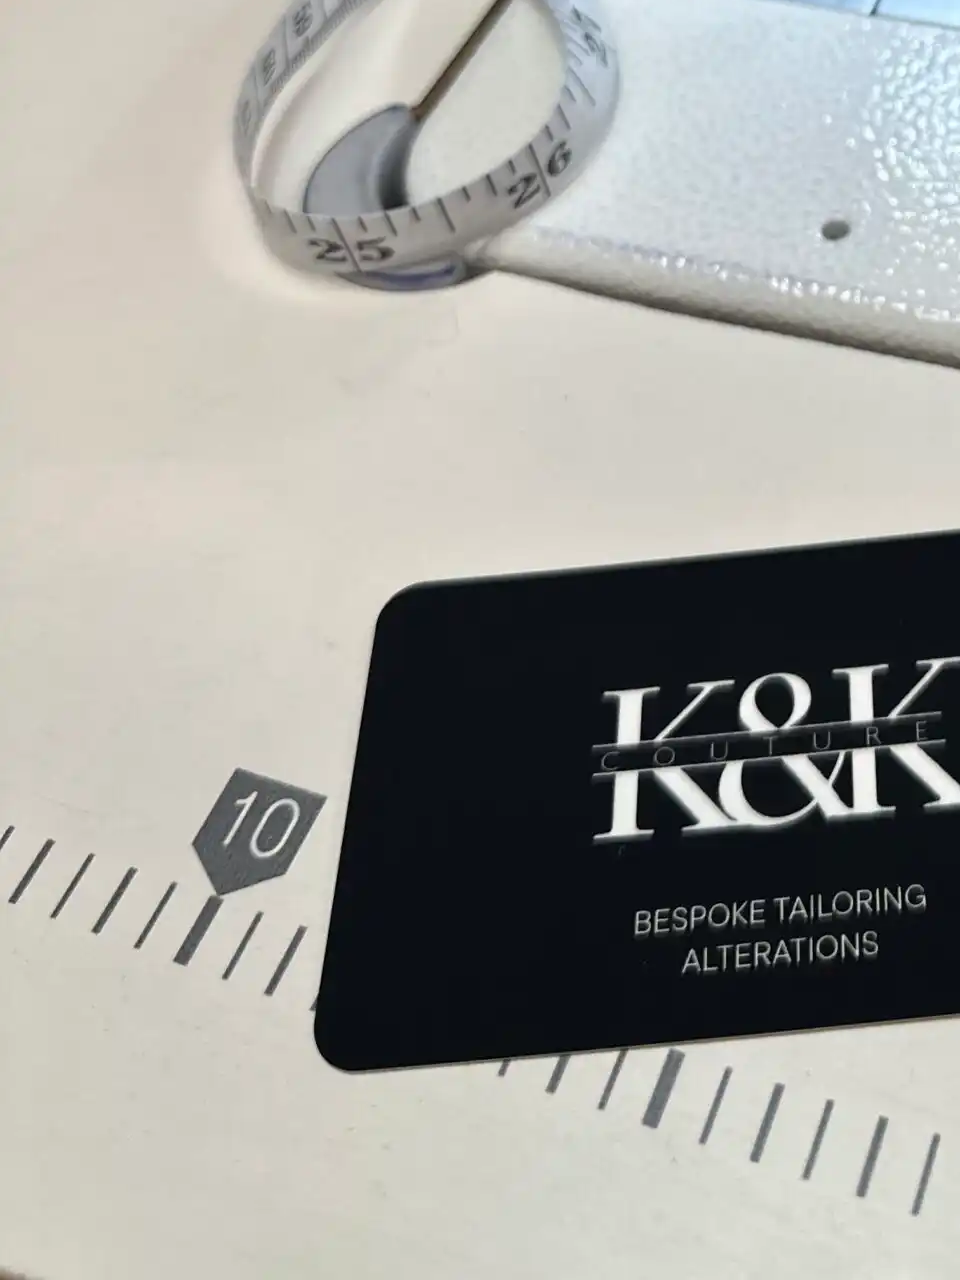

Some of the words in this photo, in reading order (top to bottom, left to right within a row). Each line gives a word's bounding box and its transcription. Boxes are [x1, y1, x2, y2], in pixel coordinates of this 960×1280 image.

[507, 139, 574, 209] 26
[307, 235, 396, 263] 25
[600, 720, 931, 771] COUTURE
[222, 790, 301, 859] 10
[633, 899, 766, 936] BESPOKE
[772, 883, 927, 925] TAILORING
[681, 930, 879, 975] ALTERATIONS
